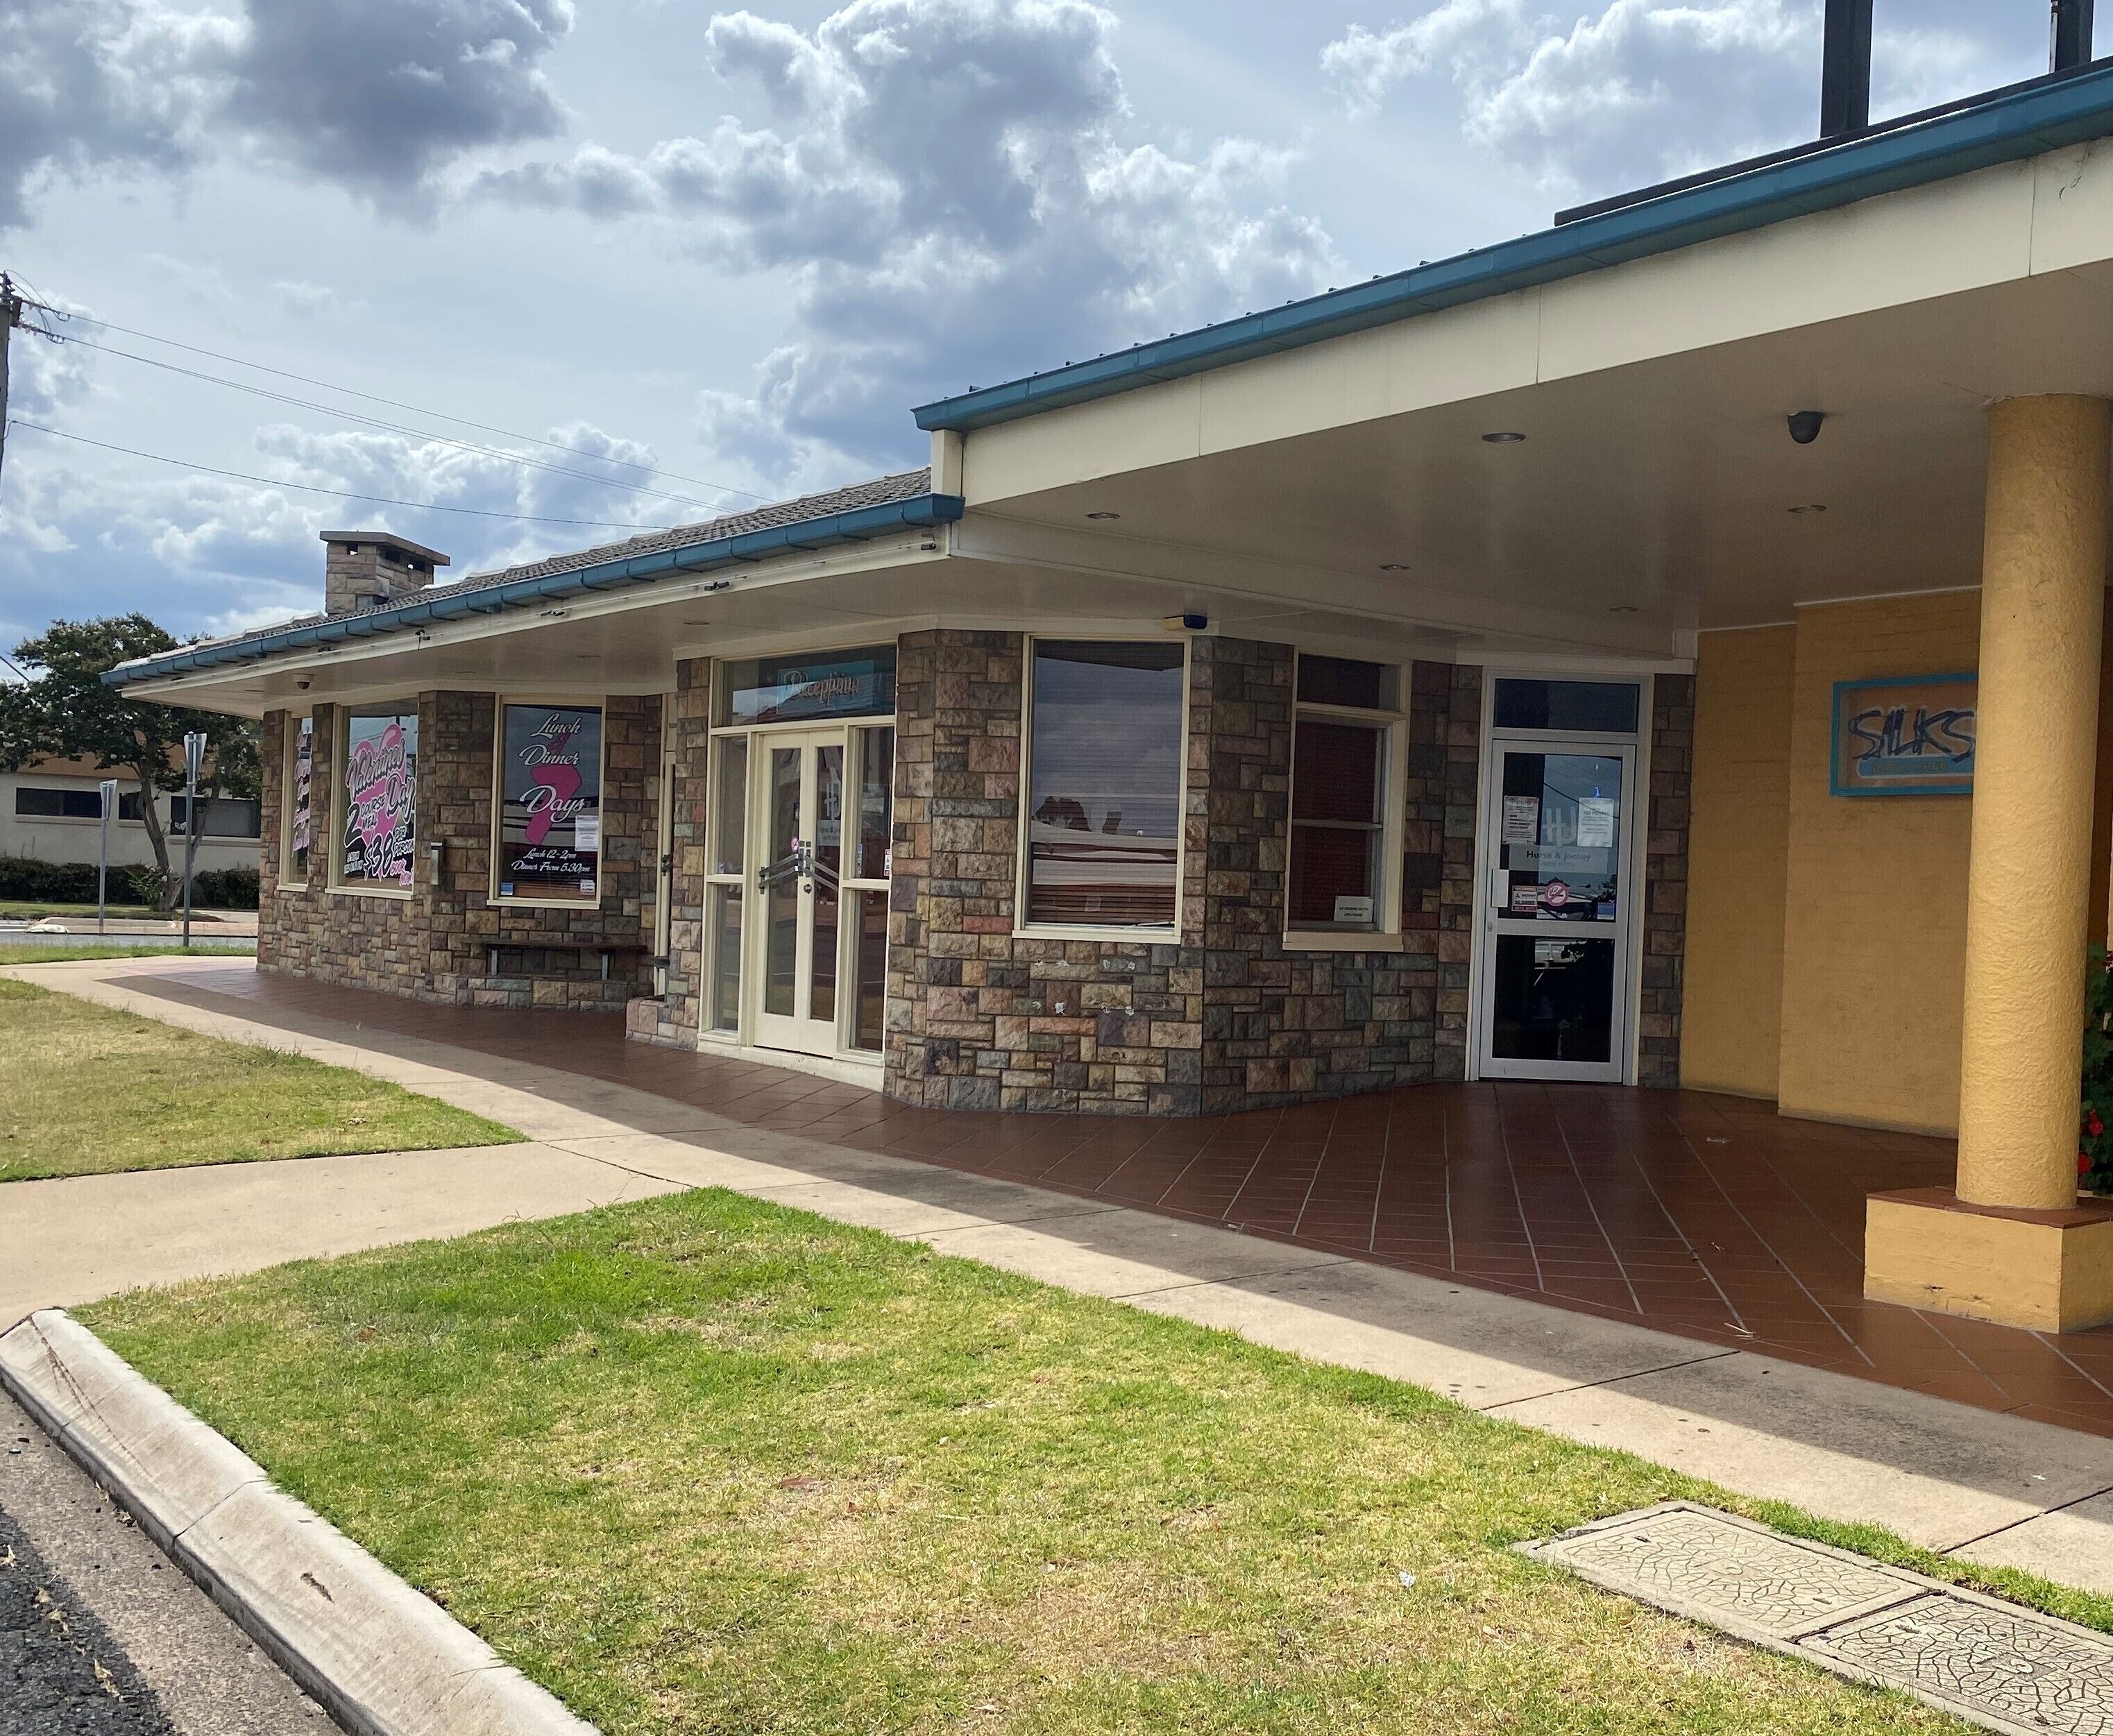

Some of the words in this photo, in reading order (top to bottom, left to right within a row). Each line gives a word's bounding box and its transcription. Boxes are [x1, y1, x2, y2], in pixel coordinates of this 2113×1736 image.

[783, 670, 860, 706] Reception
[530, 713, 582, 739] Lunch
[1848, 708, 1975, 763] SILKS
[519, 744, 580, 765] Dinner
[385, 773, 415, 824] Day
[520, 785, 585, 822] Days
[344, 802, 362, 848] 2
[511, 860, 538, 870] Dinner
[539, 862, 559, 871] From
[523, 848, 546, 860] Lunch
